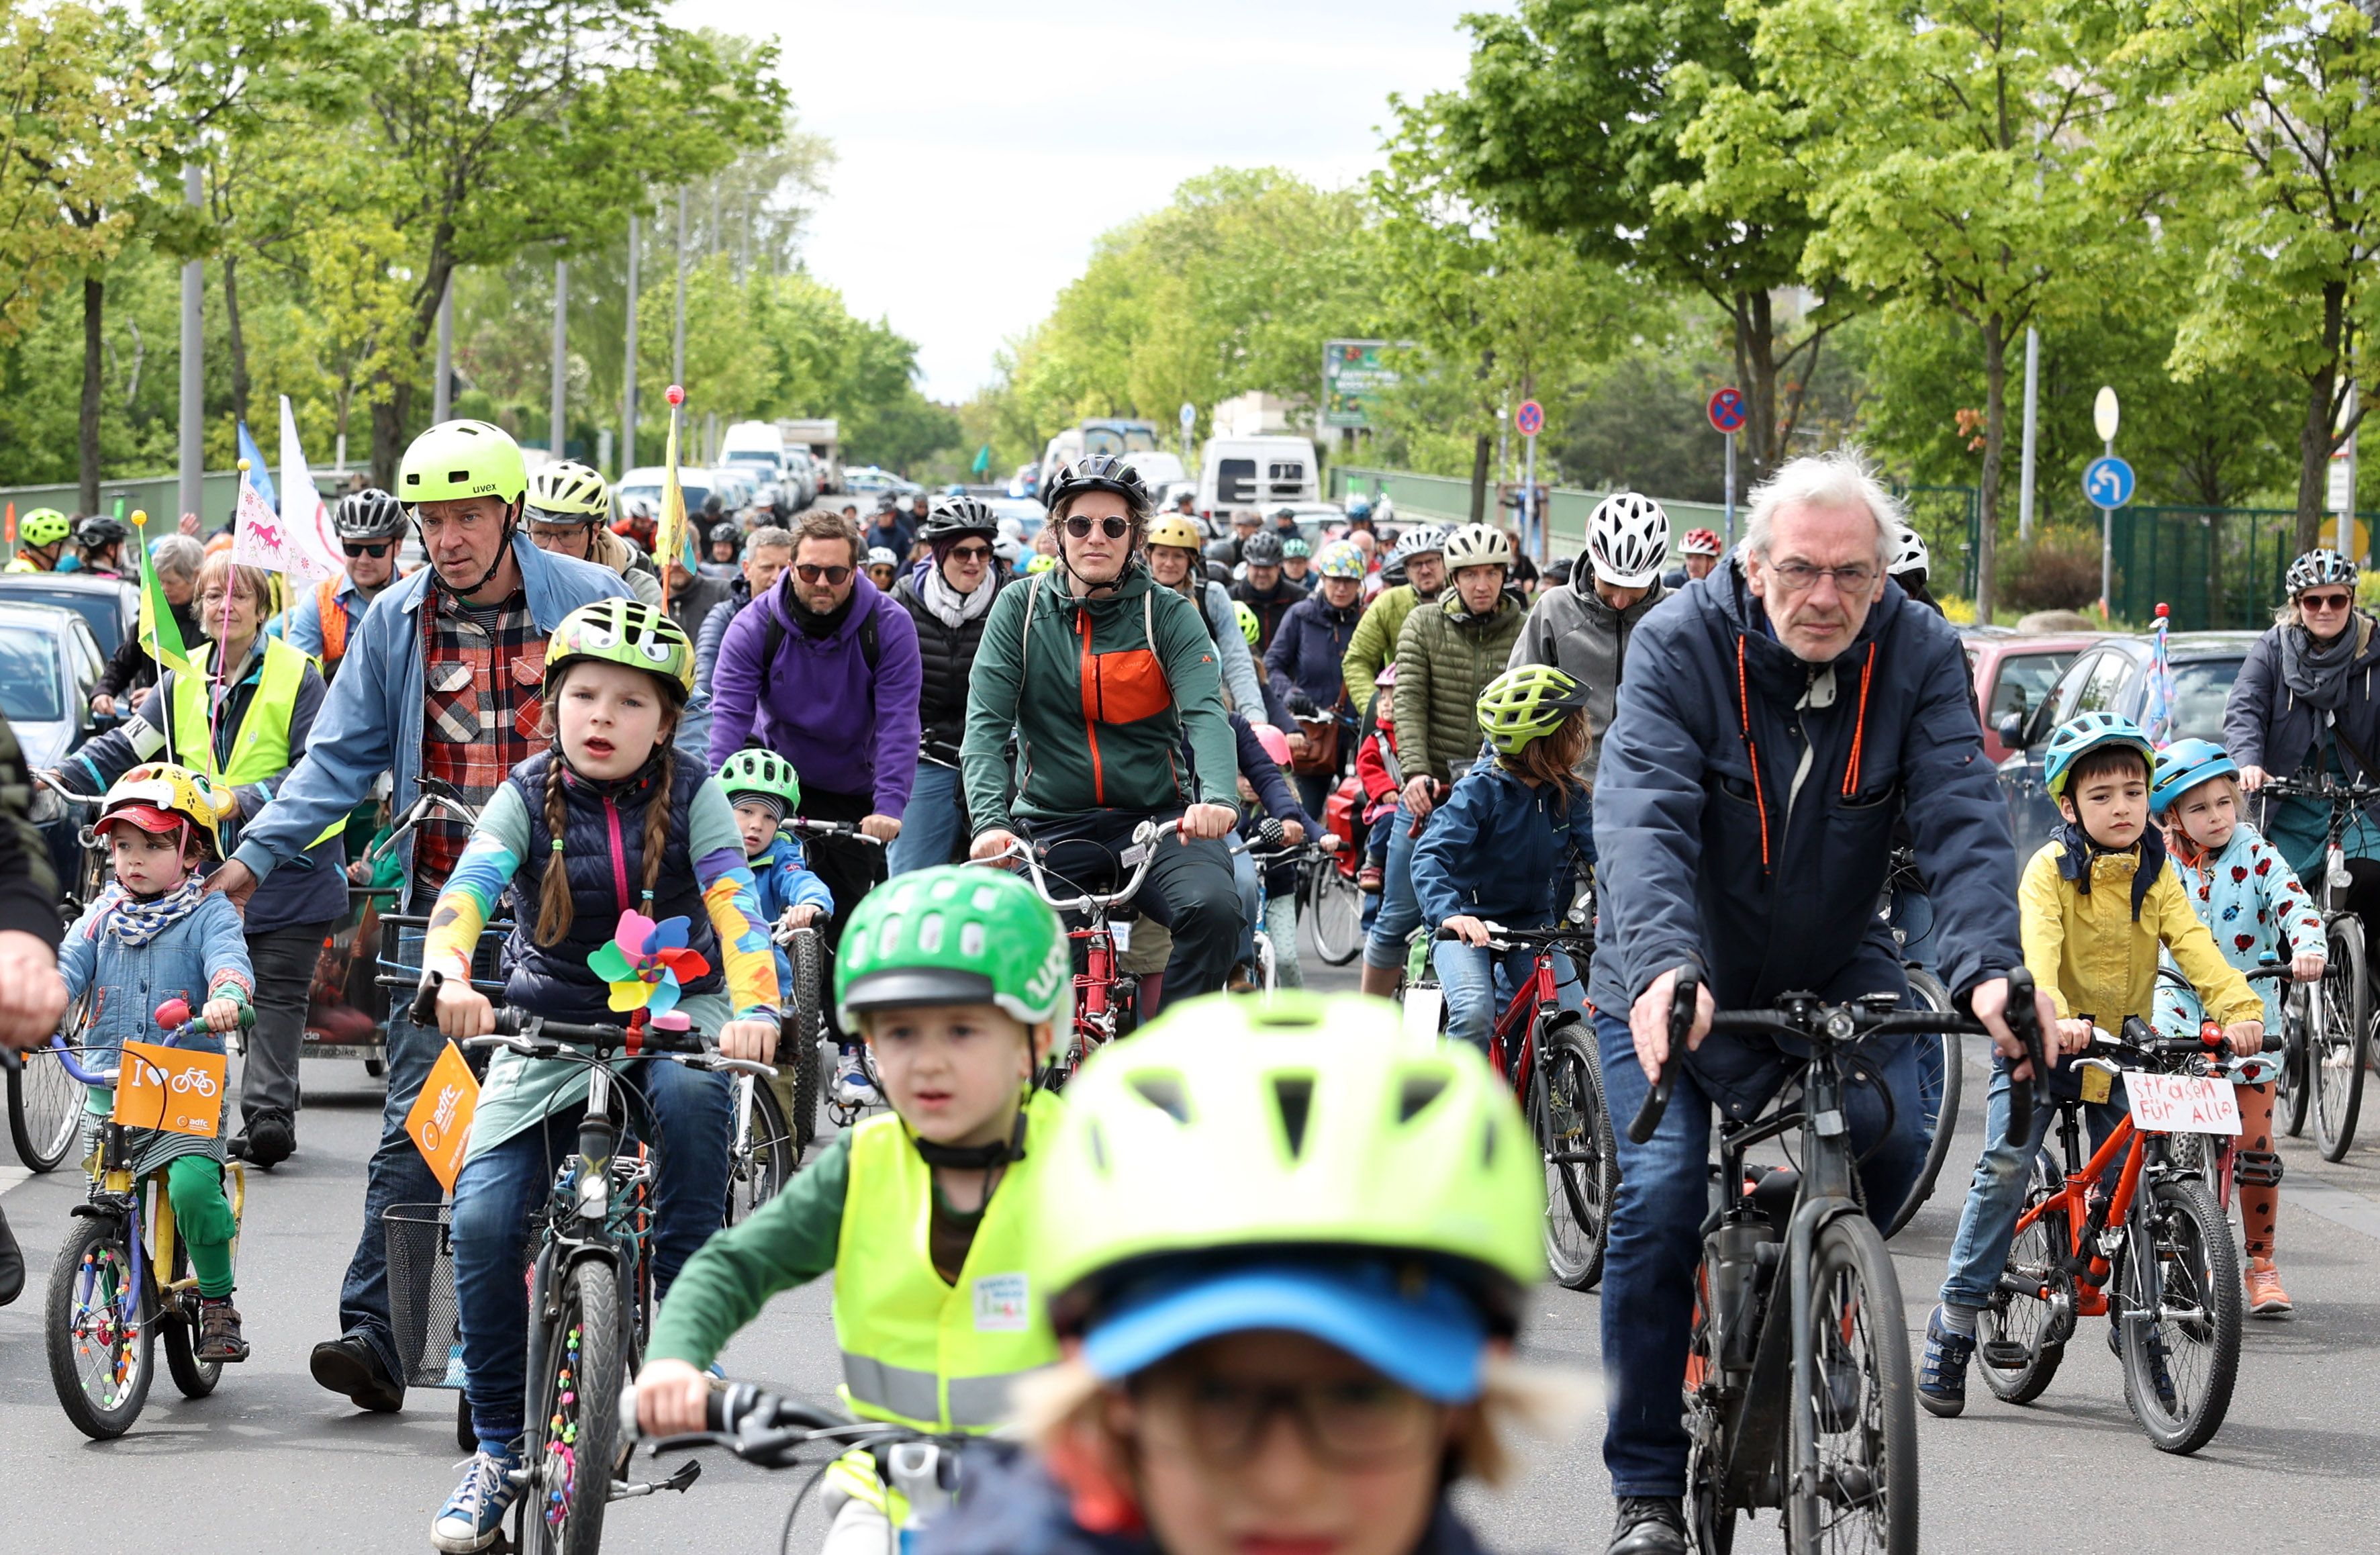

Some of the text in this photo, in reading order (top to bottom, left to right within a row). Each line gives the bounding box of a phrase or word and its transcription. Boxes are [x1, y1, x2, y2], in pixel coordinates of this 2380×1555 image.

[473, 483, 497, 493] uvex
[127, 718, 148, 739] IN
[303, 1031, 320, 1040] de
[132, 1059, 144, 1086] I
[433, 1084, 456, 1125] adfc
[189, 1118, 208, 1127] adfc
